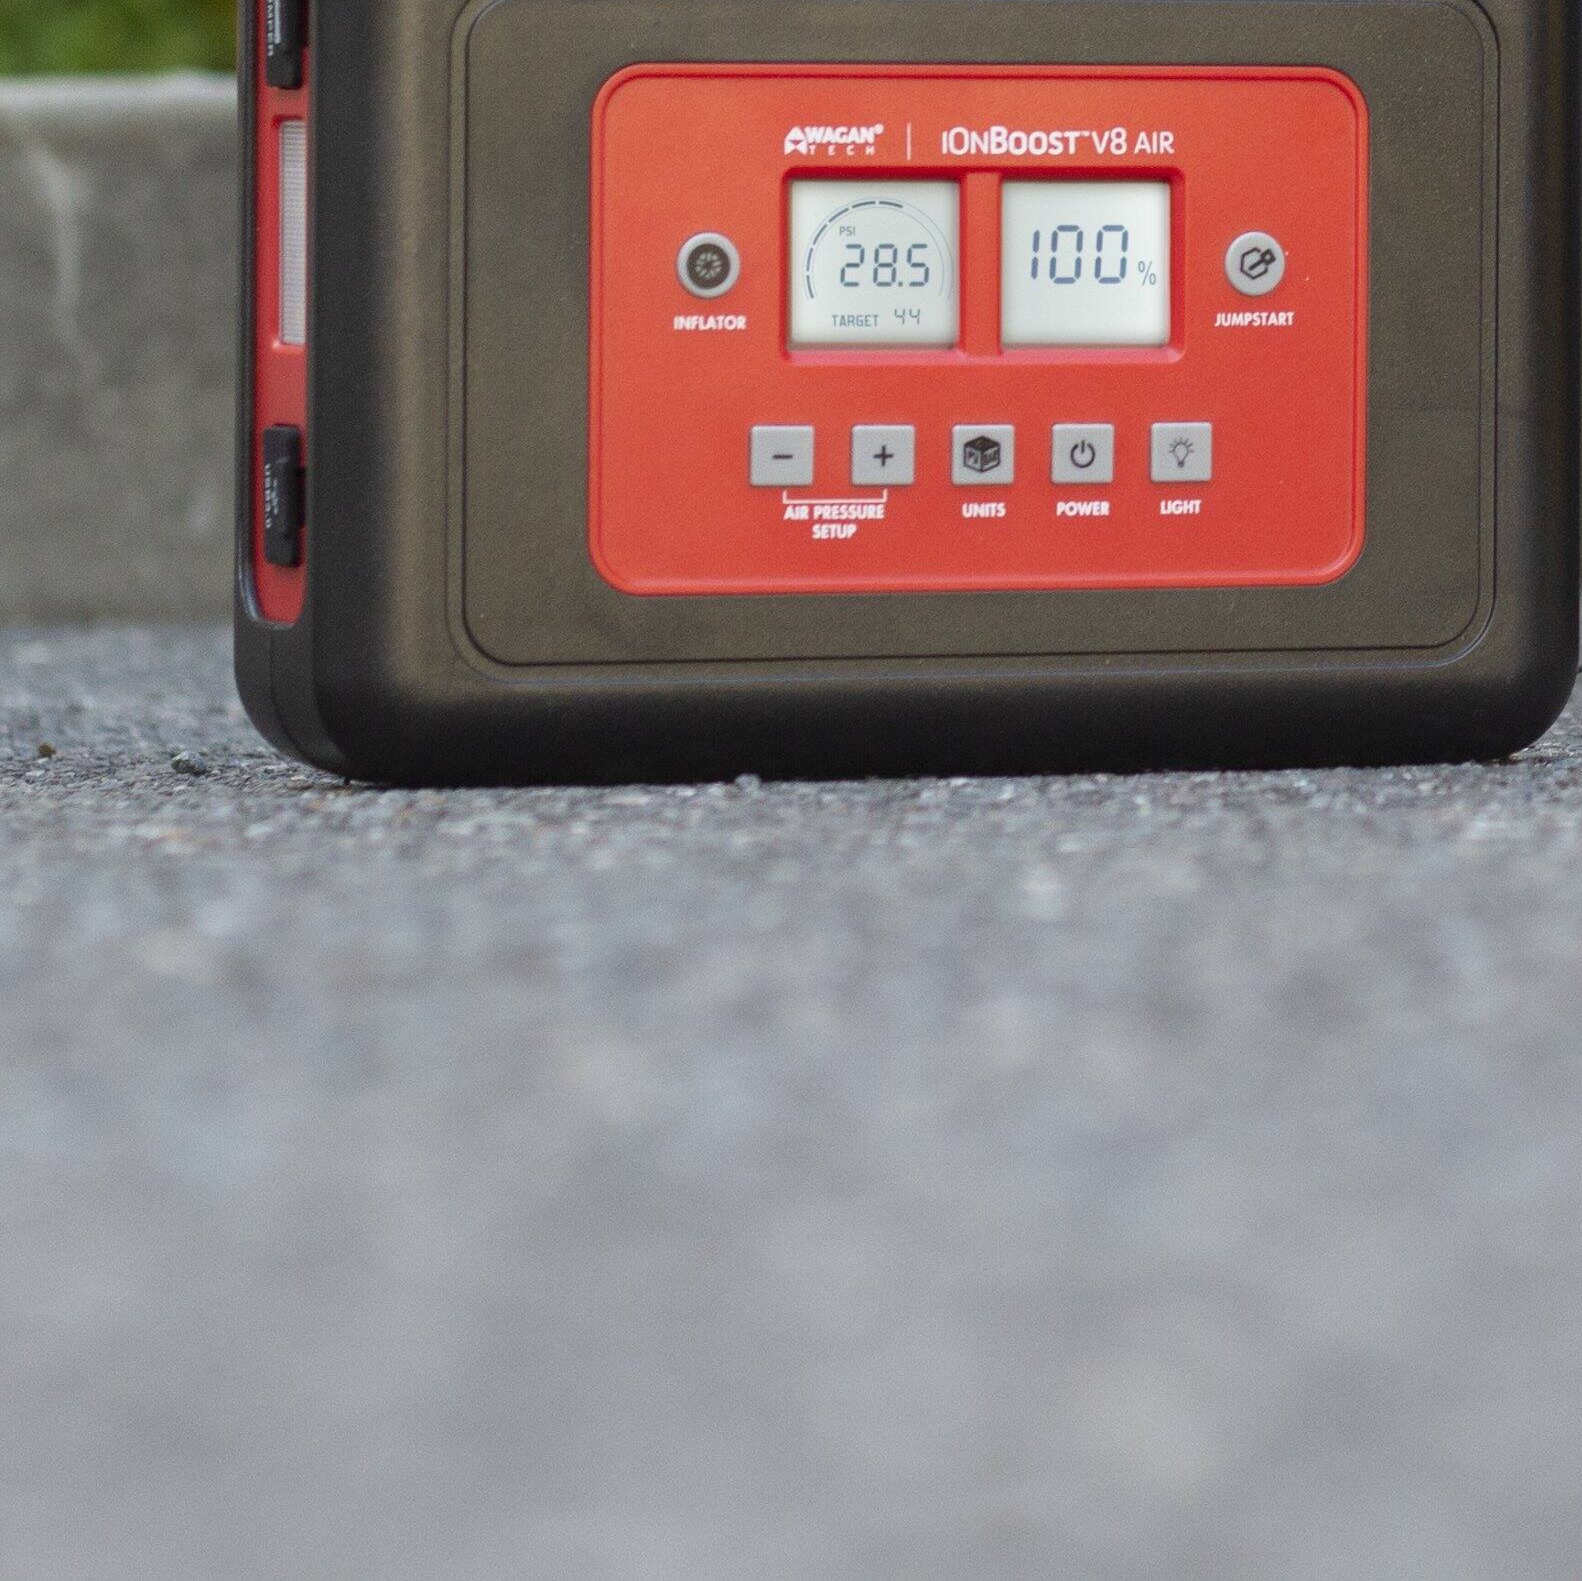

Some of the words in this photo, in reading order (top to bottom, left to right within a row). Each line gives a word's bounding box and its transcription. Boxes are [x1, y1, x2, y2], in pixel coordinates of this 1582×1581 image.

[1091, 127, 1127, 155] V8
[1133, 131, 1175, 154] AIR
[809, 145, 875, 156] TECH
[839, 226, 856, 236] PSI
[840, 243, 930, 287] 28.5
[673, 315, 747, 330] INFLATOR
[831, 314, 879, 327] TARGET
[894, 308, 920, 325] 44
[1214, 311, 1295, 327] JUMPSTART
[783, 505, 809, 519] AIR
[813, 504, 885, 519] PRESSURE
[962, 503, 1006, 518] UNITS
[1056, 501, 1110, 516] POWER
[1160, 500, 1201, 515] LIGHT
[812, 523, 857, 539] SETUP
